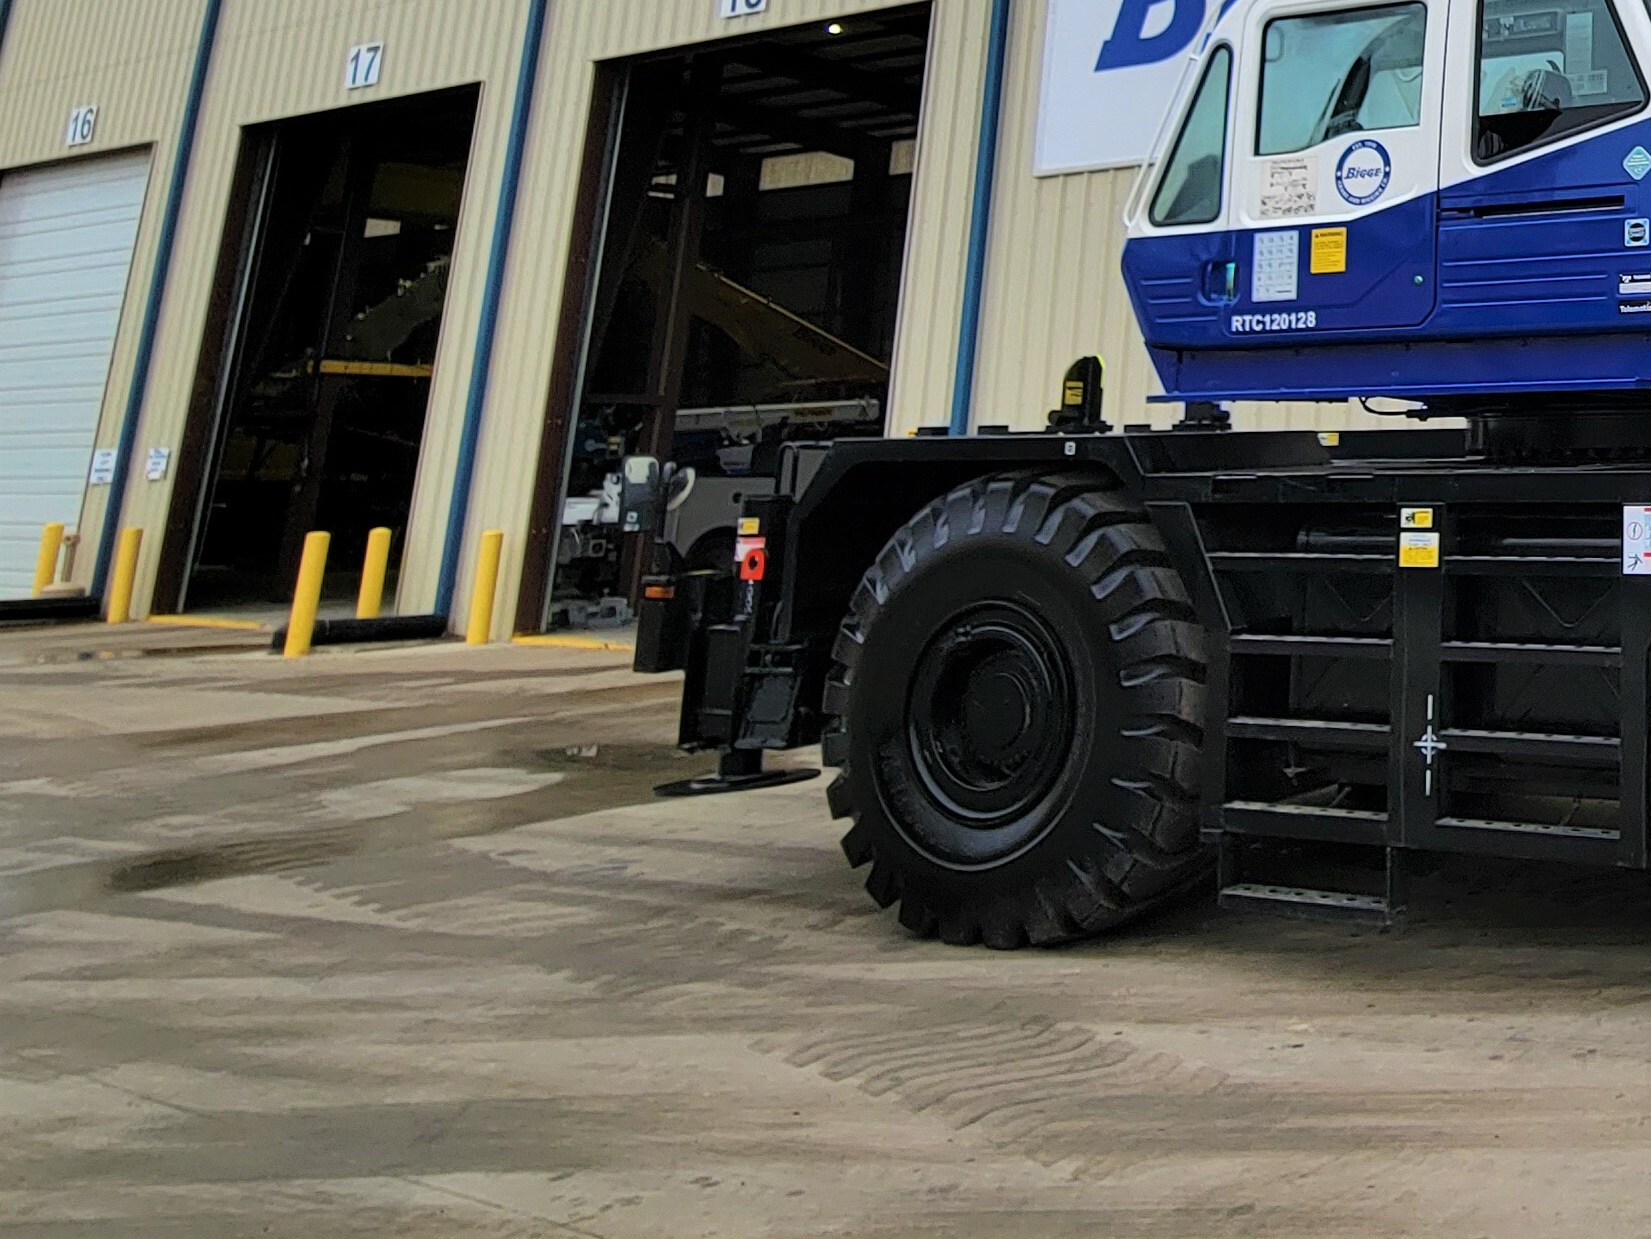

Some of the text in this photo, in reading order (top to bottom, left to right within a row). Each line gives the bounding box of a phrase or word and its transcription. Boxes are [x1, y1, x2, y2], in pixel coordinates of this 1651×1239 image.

[351, 45, 380, 85] 17
[72, 107, 94, 142] 16
[1231, 310, 1317, 332] RTC120128
